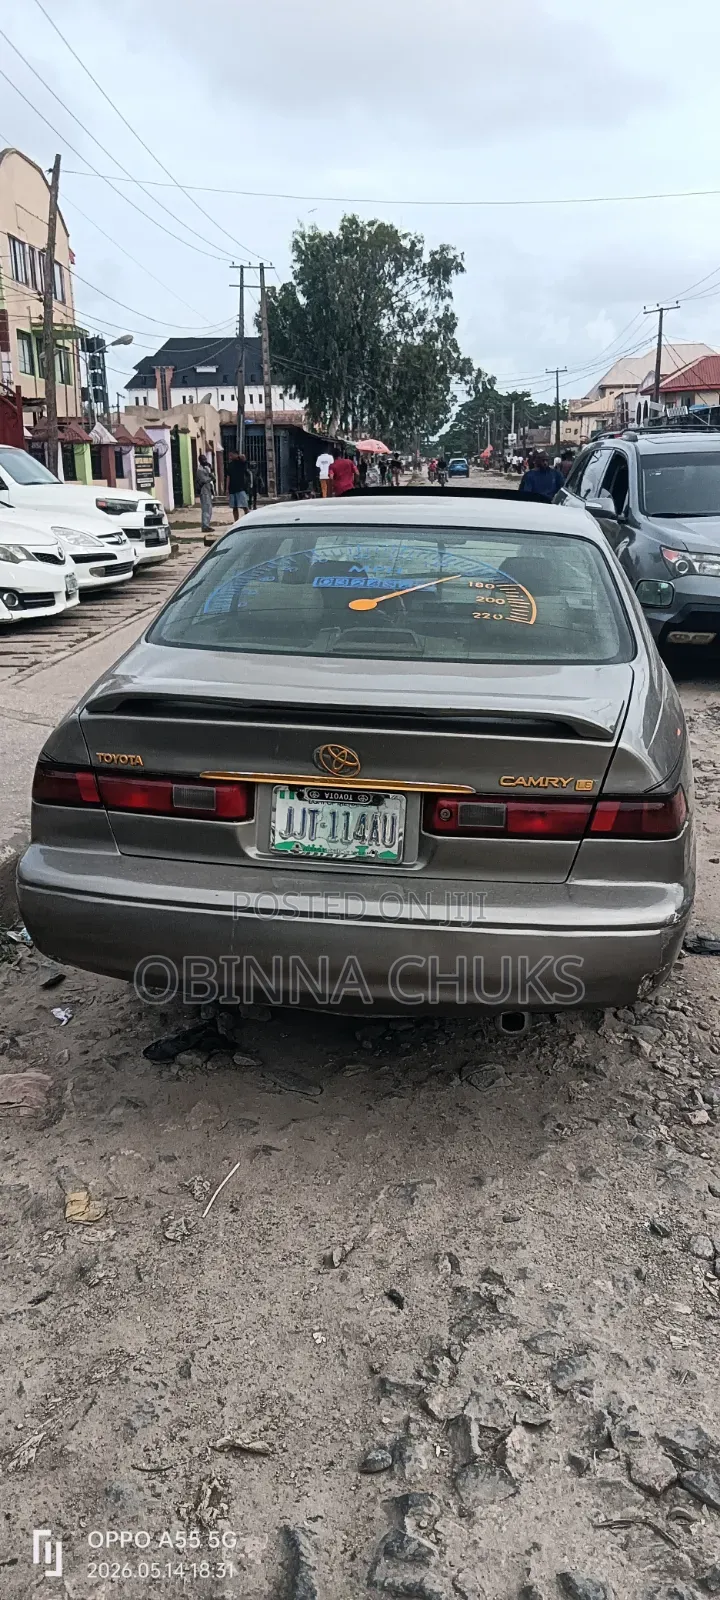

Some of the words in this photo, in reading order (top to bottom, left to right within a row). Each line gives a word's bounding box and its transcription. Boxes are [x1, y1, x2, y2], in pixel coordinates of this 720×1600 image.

[468, 581, 495, 589] 180
[475, 595, 505, 605] 200
[472, 612, 503, 620] 220
[96, 752, 144, 766] TOYOTA
[500, 775, 574, 788] CAMRY
[576, 780, 594, 791] LE
[324, 792, 353, 801] TOYOTA
